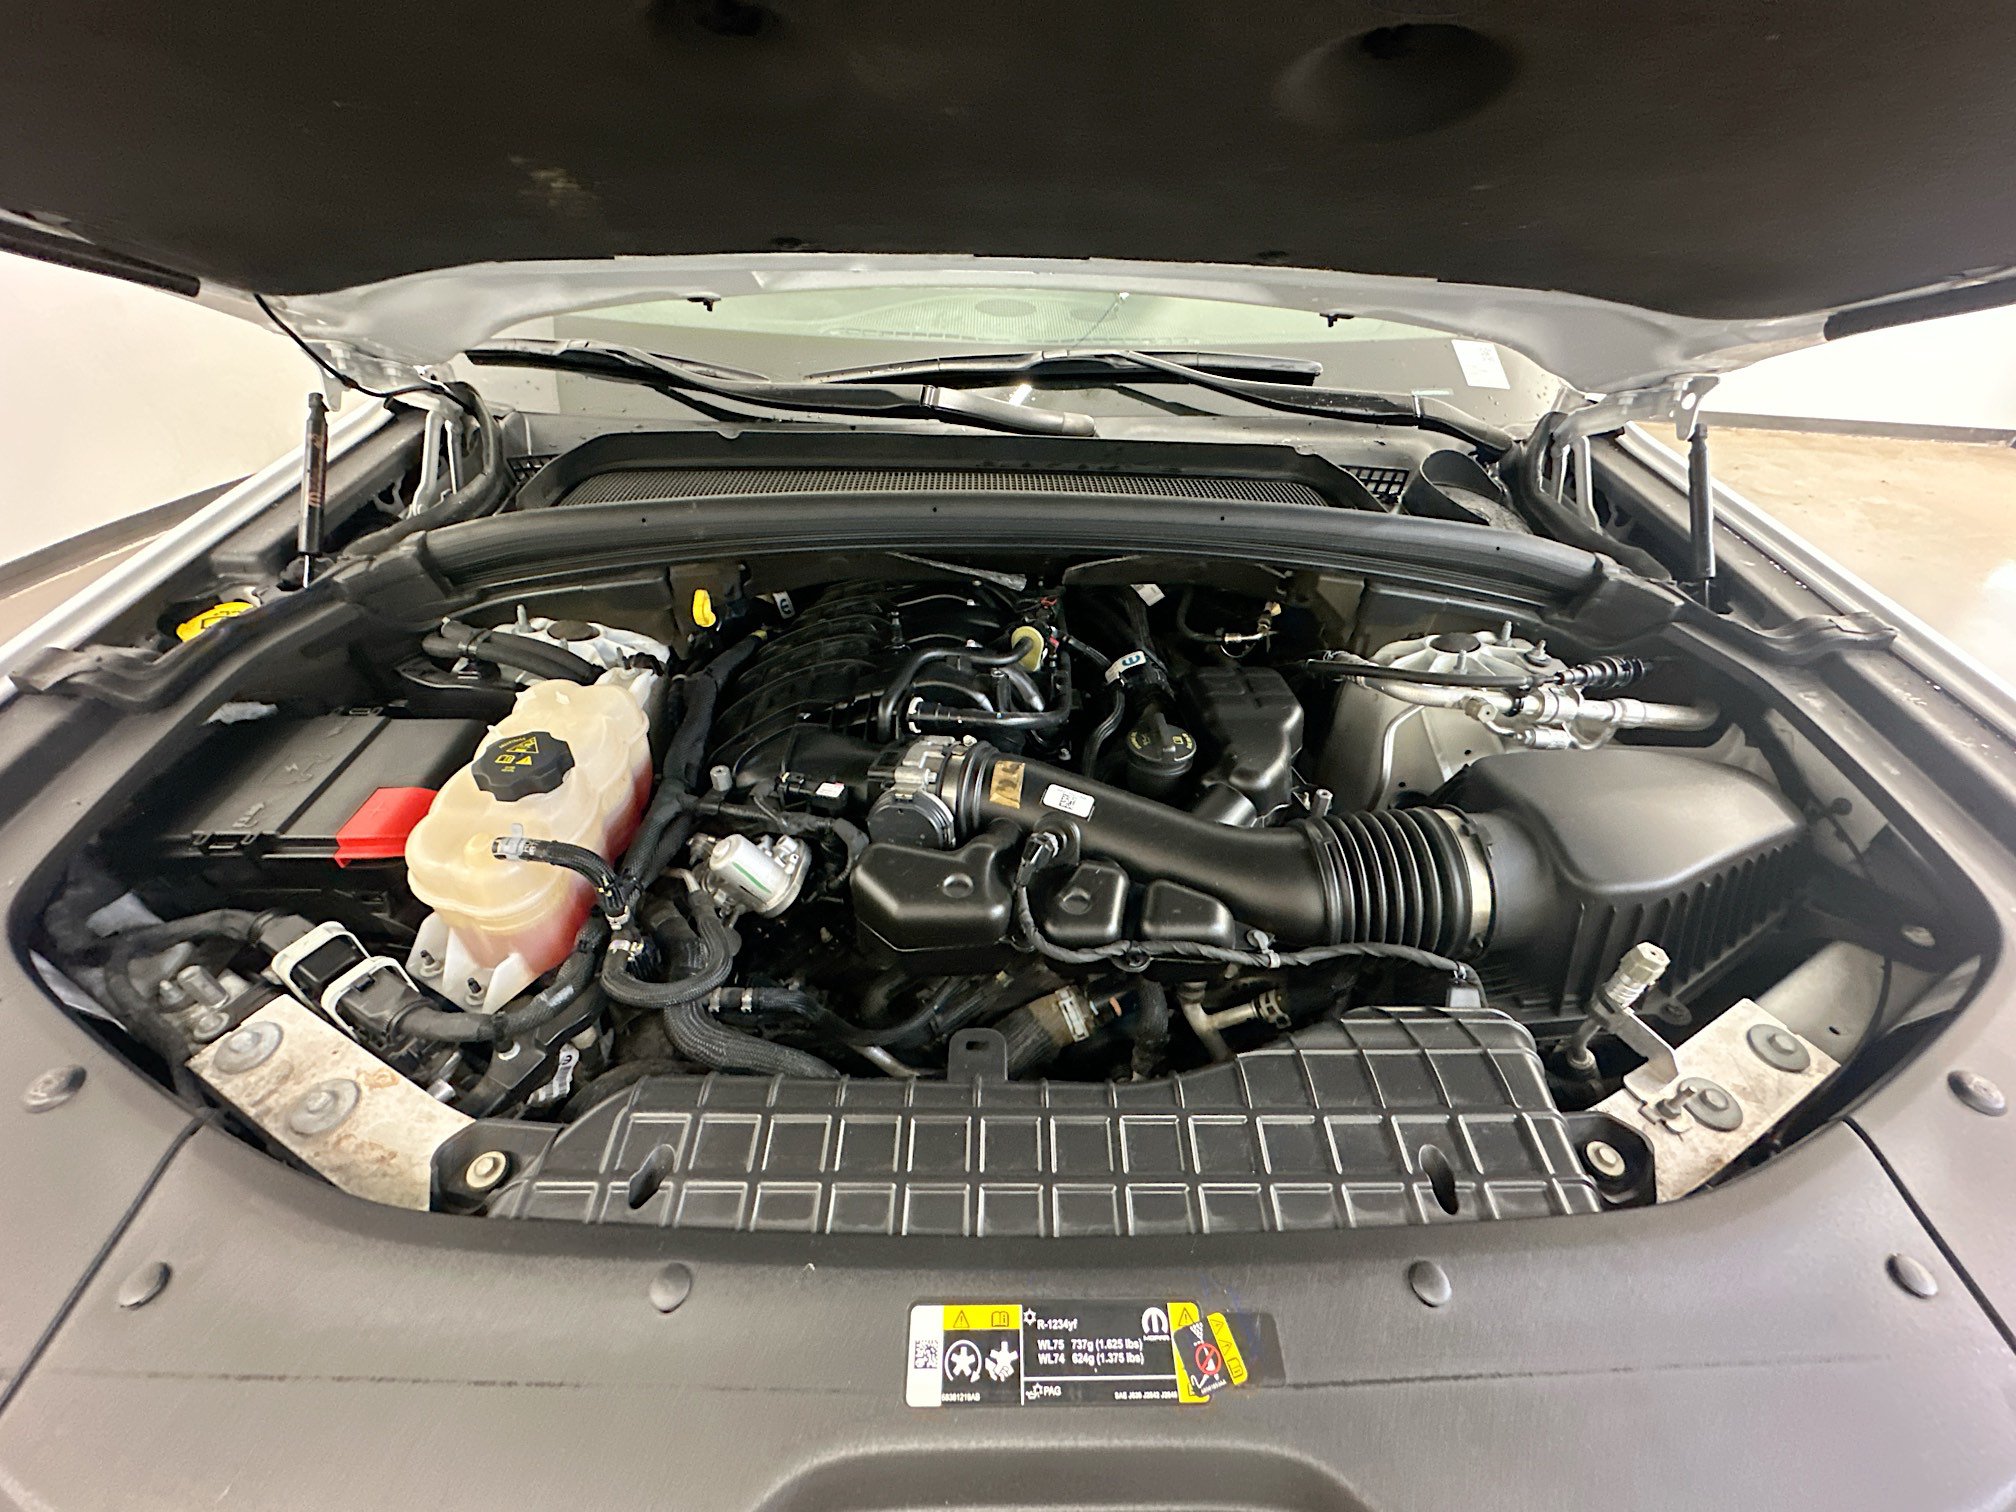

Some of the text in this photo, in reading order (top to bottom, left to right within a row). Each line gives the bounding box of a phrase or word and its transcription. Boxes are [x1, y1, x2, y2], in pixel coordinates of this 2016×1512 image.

[1037, 1318, 1077, 1331] R-1234yf
[1037, 1338, 1143, 1352] WL75 737g (1.625 lbs)
[1038, 1352, 1144, 1366] WL74 624g (1.375 lbs)
[1044, 1386, 1061, 1396] PAG
